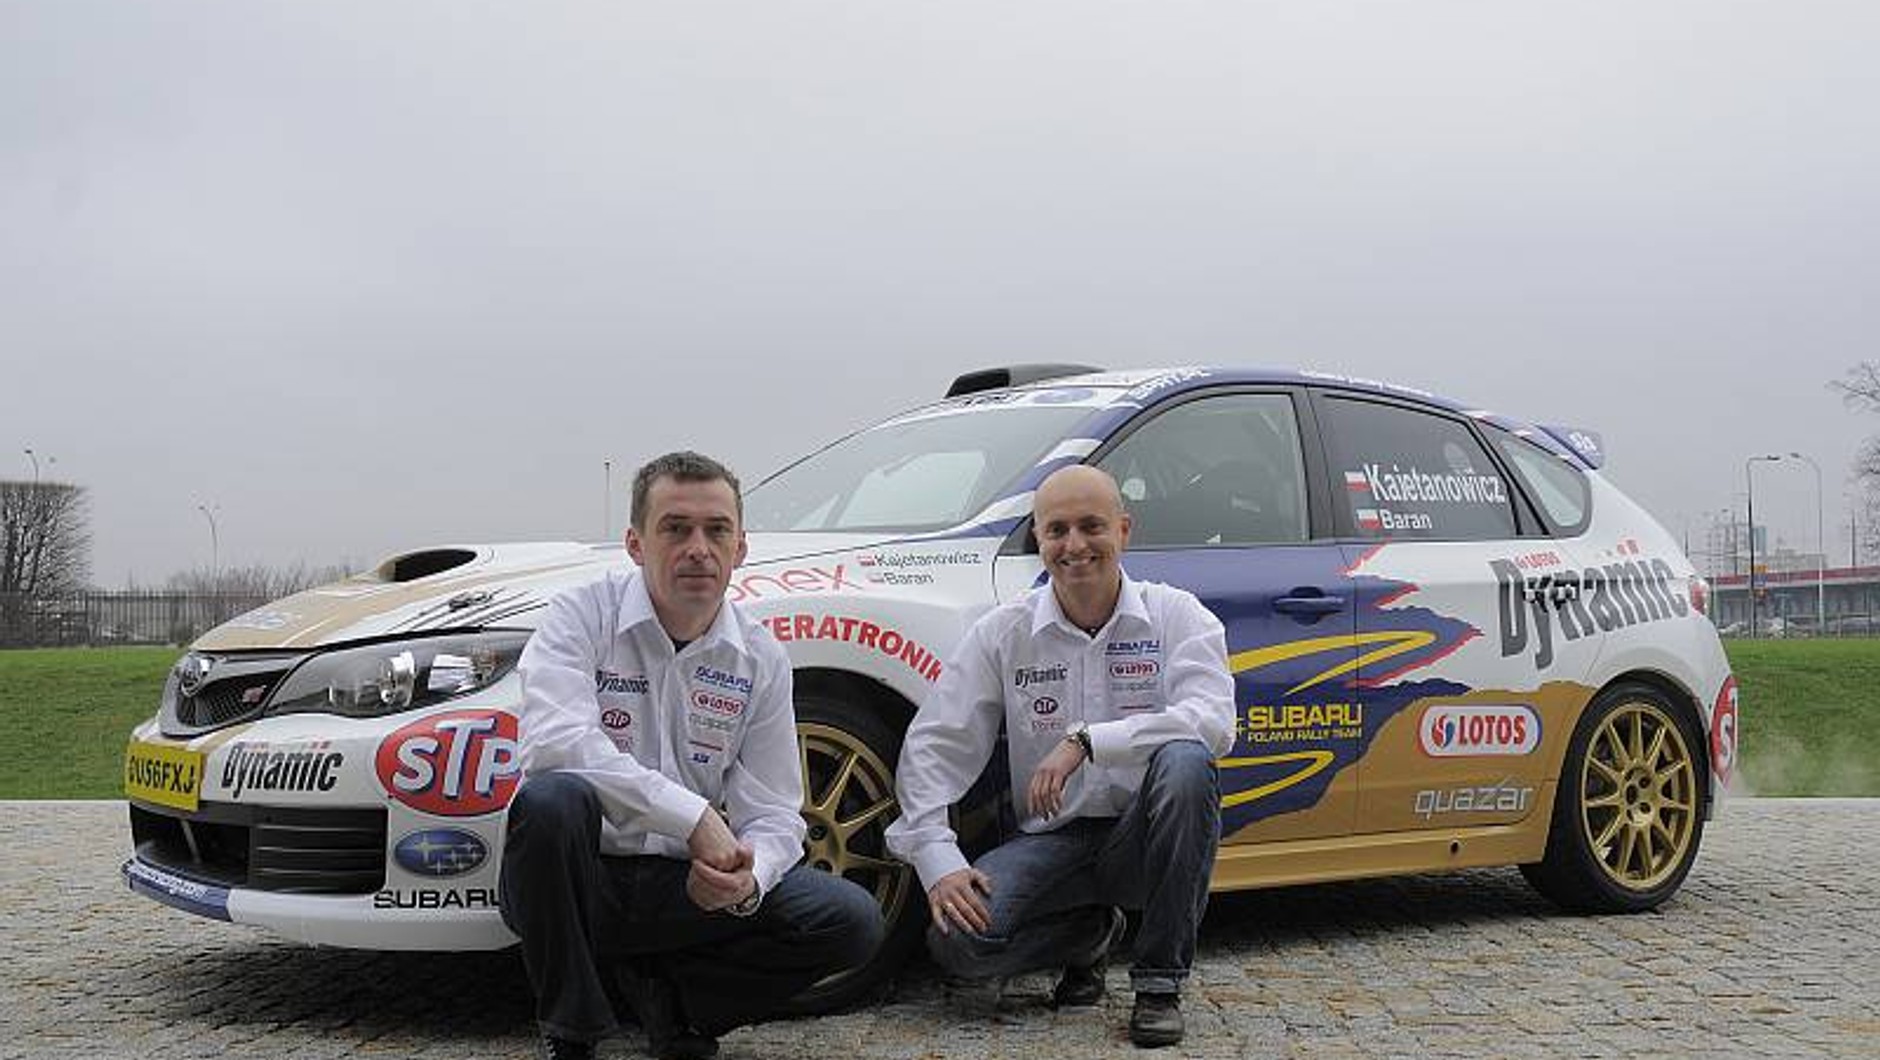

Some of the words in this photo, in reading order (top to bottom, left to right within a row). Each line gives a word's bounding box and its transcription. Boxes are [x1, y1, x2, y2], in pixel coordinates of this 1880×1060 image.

[1379, 508, 1433, 529] Baran
[883, 572, 934, 585] Baran
[1490, 557, 1690, 669] Dynamic
[762, 613, 944, 683] ERATRONIK
[604, 709, 629, 727] STP
[1248, 703, 1362, 729] SUBARU
[1458, 714, 1526, 745] LOTOS
[1248, 730, 1294, 742] POLAND
[1297, 728, 1330, 740] RALLY
[1332, 726, 1362, 738] TEAM
[221, 741, 343, 798] Dynamic
[392, 717, 522, 798] STP
[1415, 783, 1534, 820] quazar
